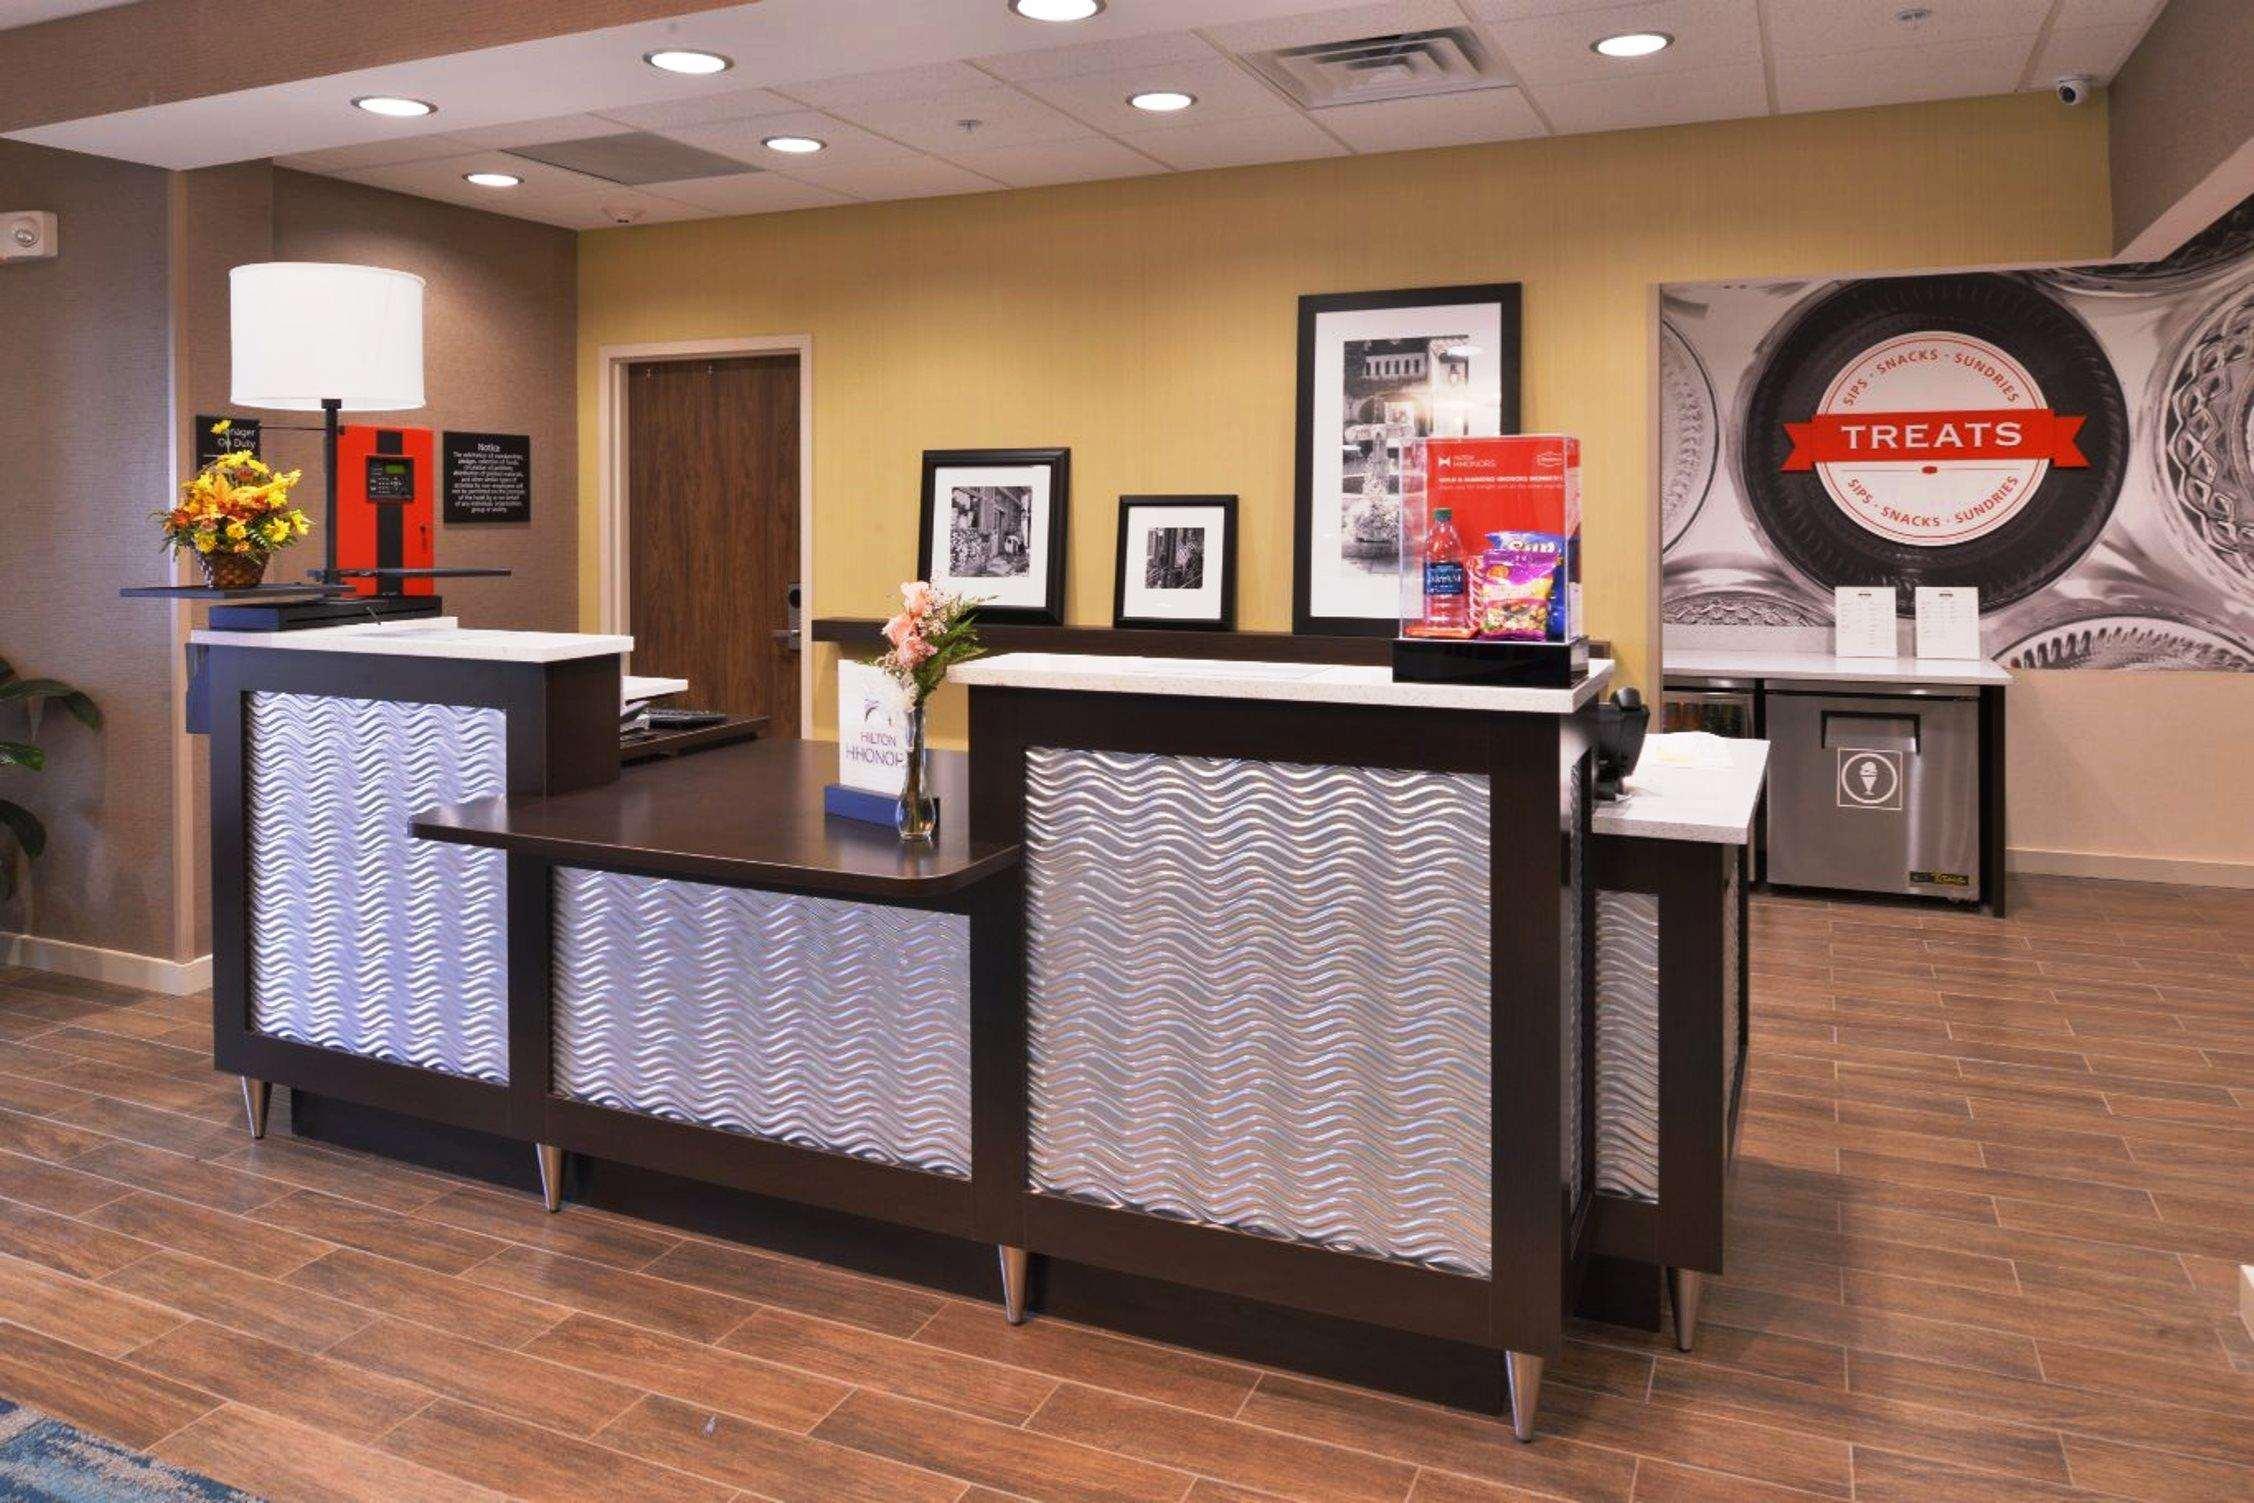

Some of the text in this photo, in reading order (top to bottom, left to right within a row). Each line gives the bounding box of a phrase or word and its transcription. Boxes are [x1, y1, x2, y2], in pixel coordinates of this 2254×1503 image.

[1843, 348, 2019, 406] SIPS SNACKS SUNDRIES
[477, 443, 501, 453] Notice
[1841, 421, 2023, 451] TREATS
[1848, 475, 2018, 527] SIPS SNACKS SUNDRIES
[860, 731, 897, 748] HILTON
